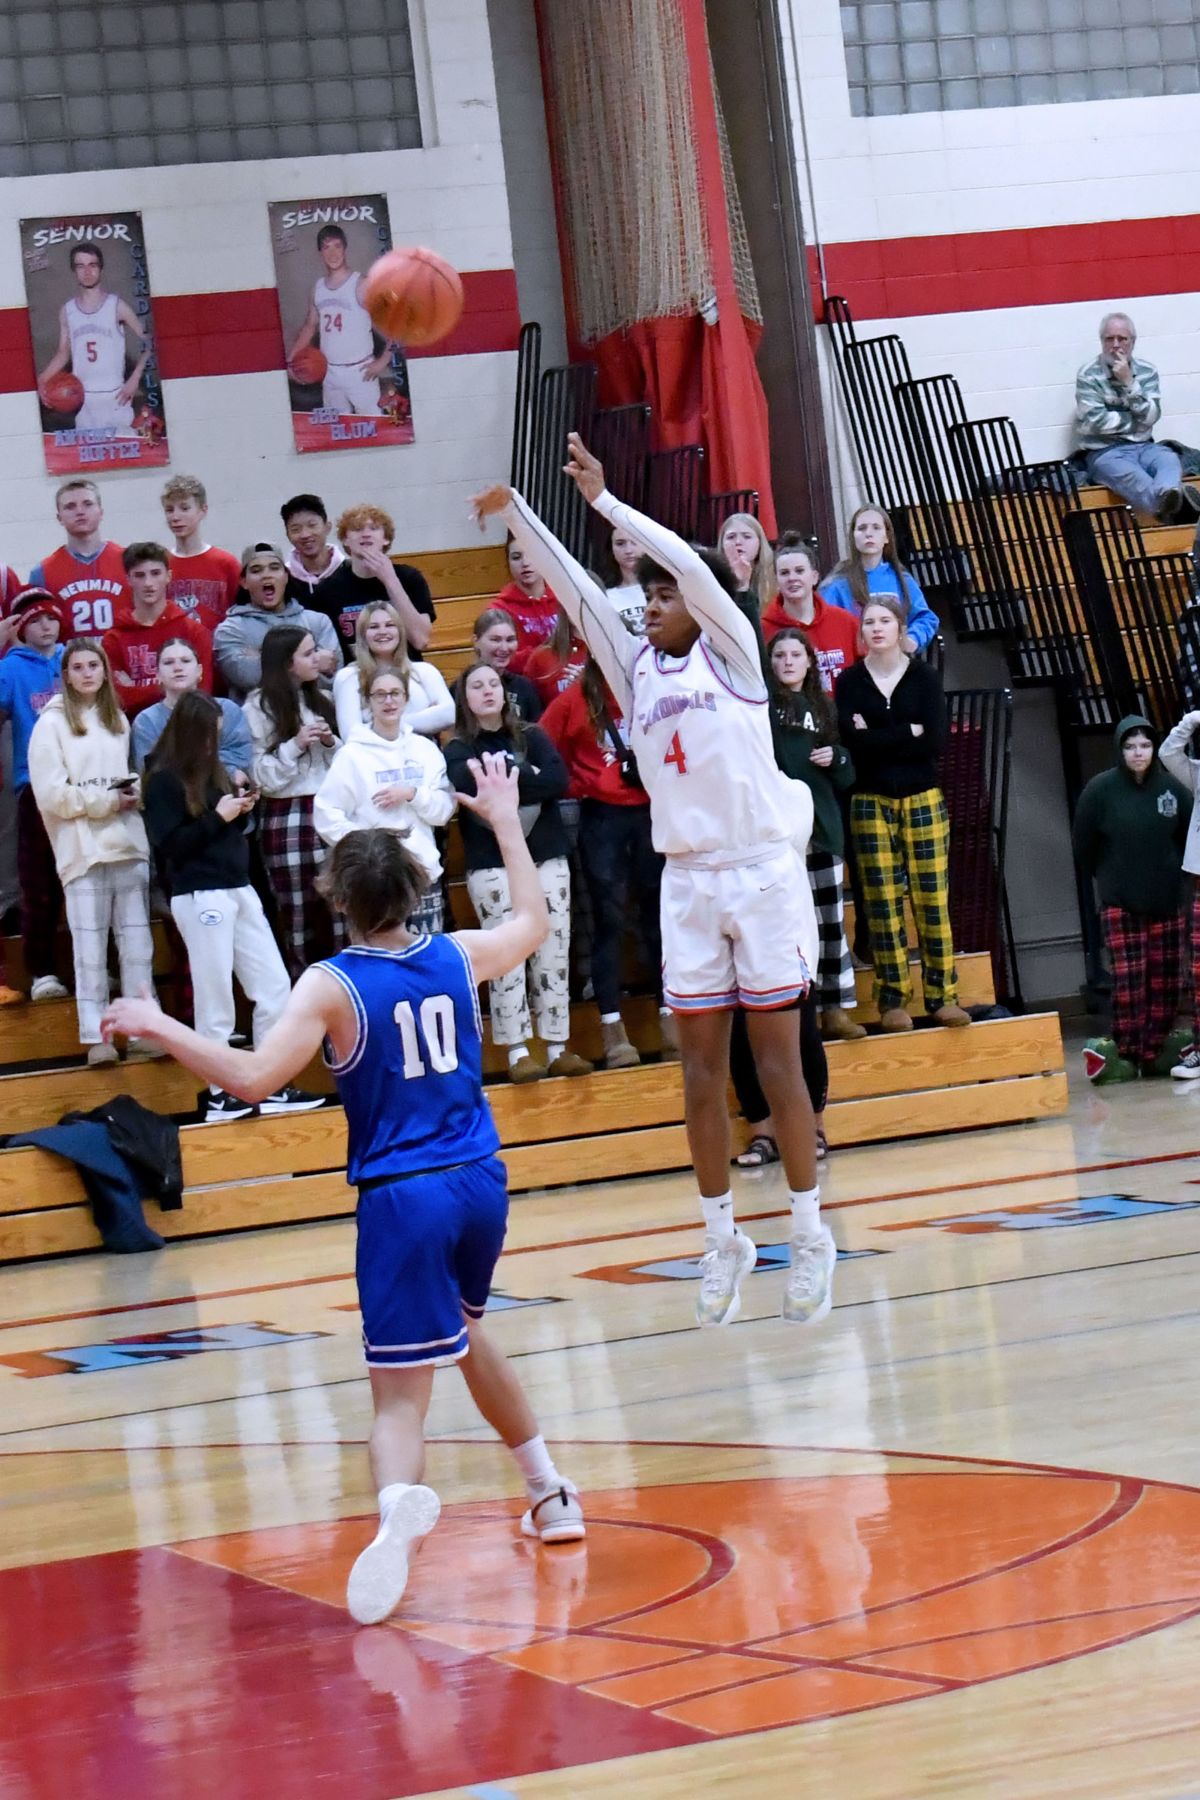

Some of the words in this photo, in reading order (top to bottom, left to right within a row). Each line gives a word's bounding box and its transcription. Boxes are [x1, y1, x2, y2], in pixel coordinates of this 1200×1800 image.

[282, 206, 378, 229] SENIOR
[33, 224, 132, 247] SENIOR
[324, 313, 343, 333] 24
[86, 341, 97, 363] 5
[331, 421, 378, 441] BLUM
[58, 578, 123, 600] NEWMAN
[72, 598, 113, 632] 20
[664, 729, 688, 775] 4
[393, 993, 459, 1080] 10
